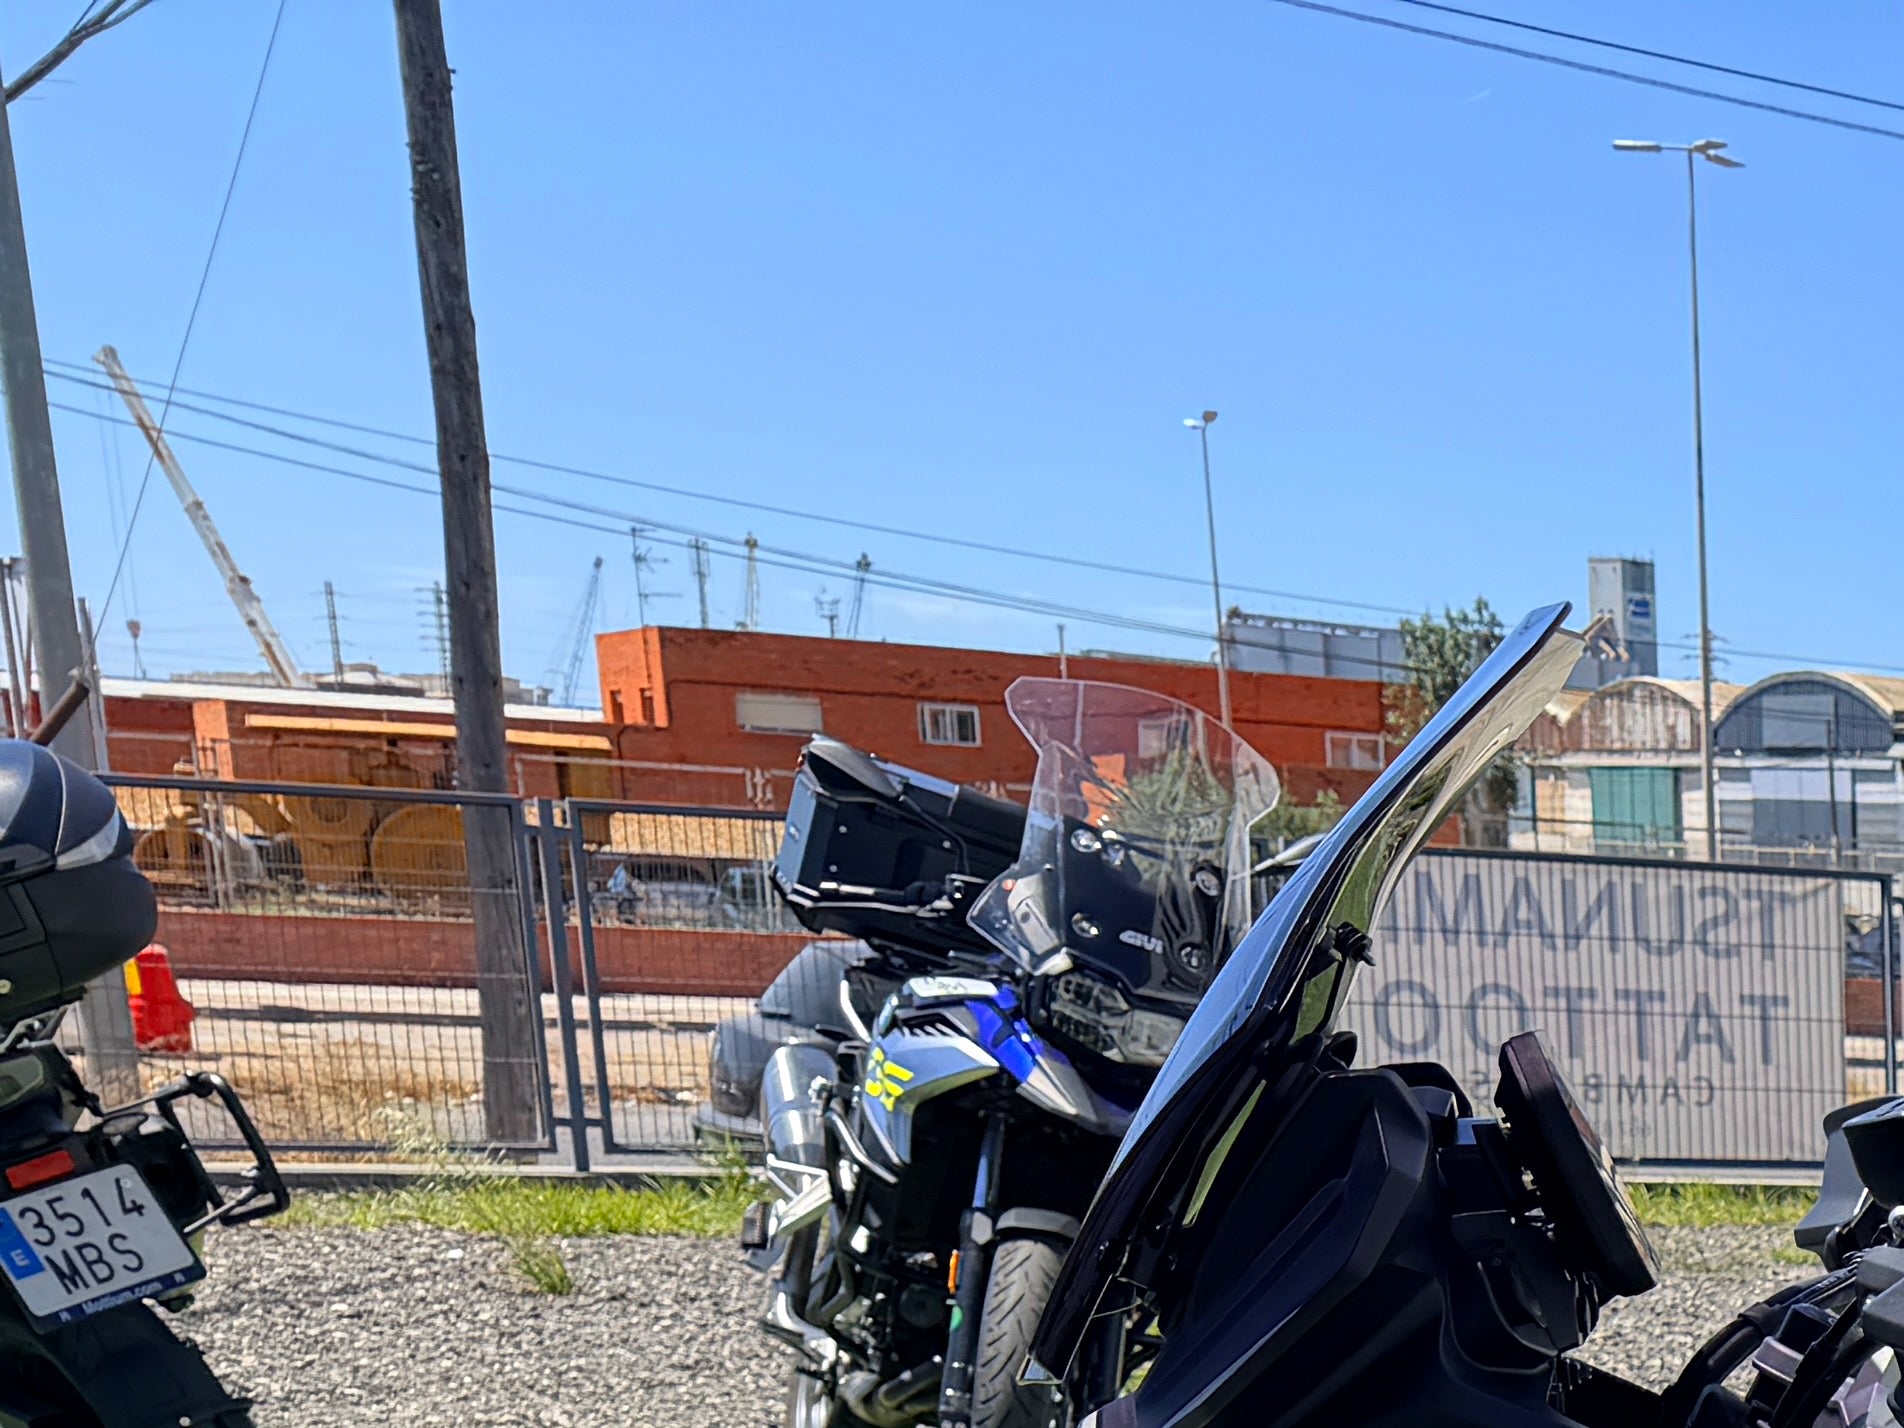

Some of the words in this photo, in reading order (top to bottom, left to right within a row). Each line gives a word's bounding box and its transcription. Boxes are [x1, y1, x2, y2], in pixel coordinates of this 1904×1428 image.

[18, 1177, 146, 1247] 3514
[10, 1249, 30, 1267] E
[45, 1233, 144, 1294] MBS
